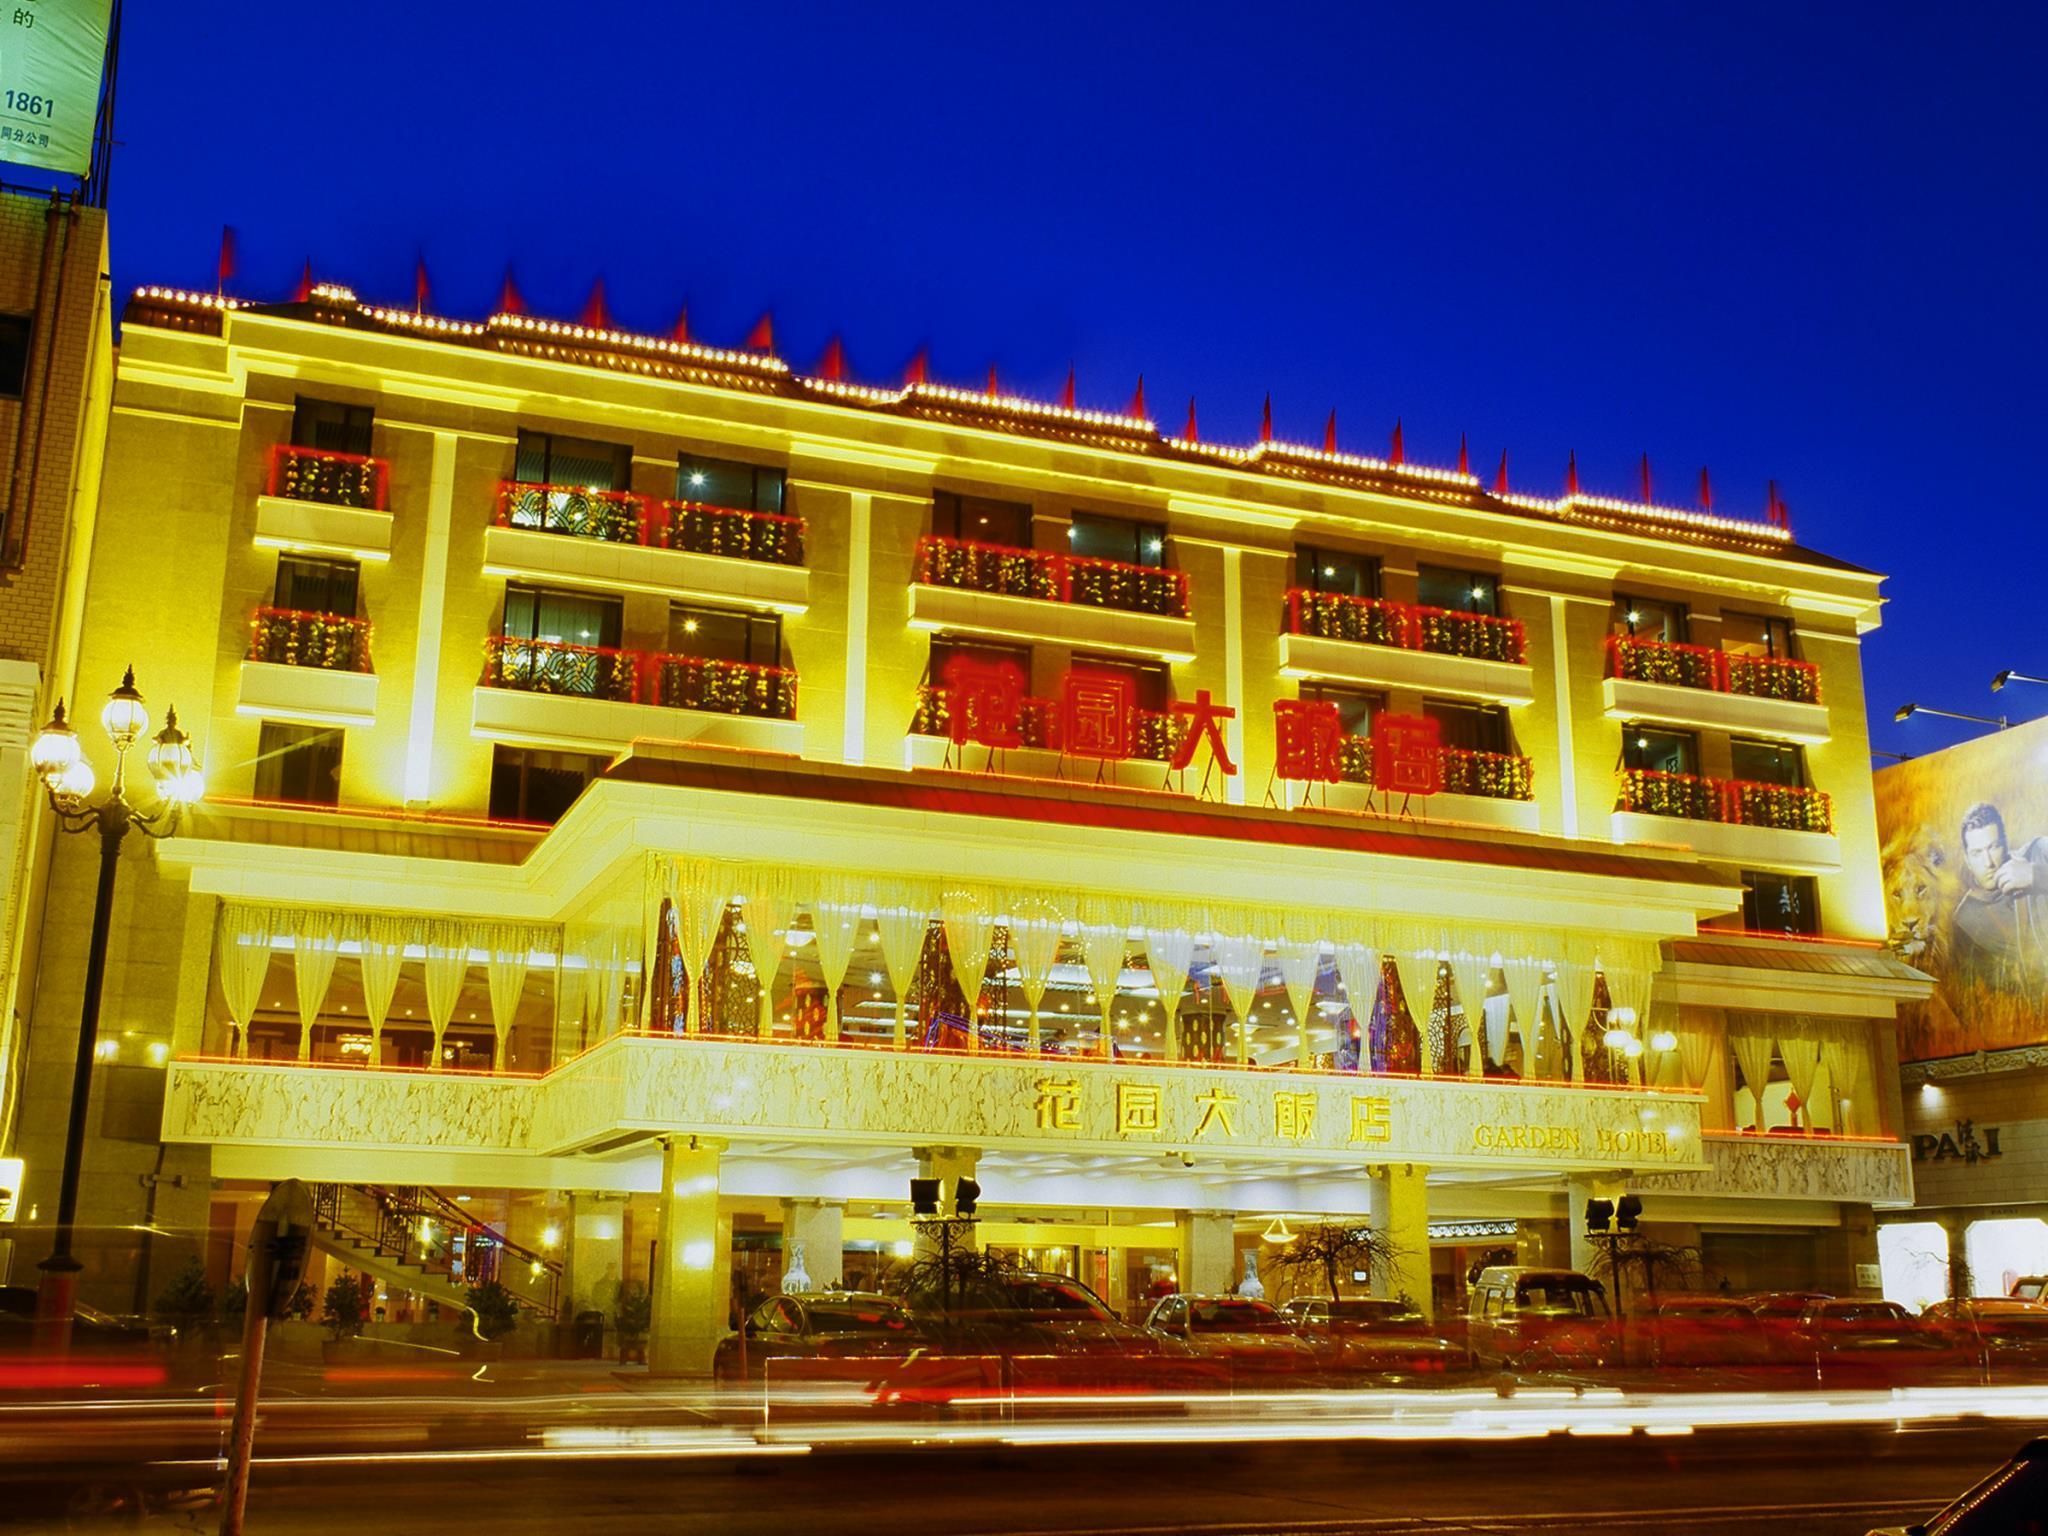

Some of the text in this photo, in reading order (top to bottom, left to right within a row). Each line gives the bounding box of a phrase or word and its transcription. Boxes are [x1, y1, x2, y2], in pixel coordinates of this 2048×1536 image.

[13, 7, 34, 29] 的
[5, 90, 54, 118] 1861
[1473, 1123, 1678, 1156] GARDEN HOTEL
